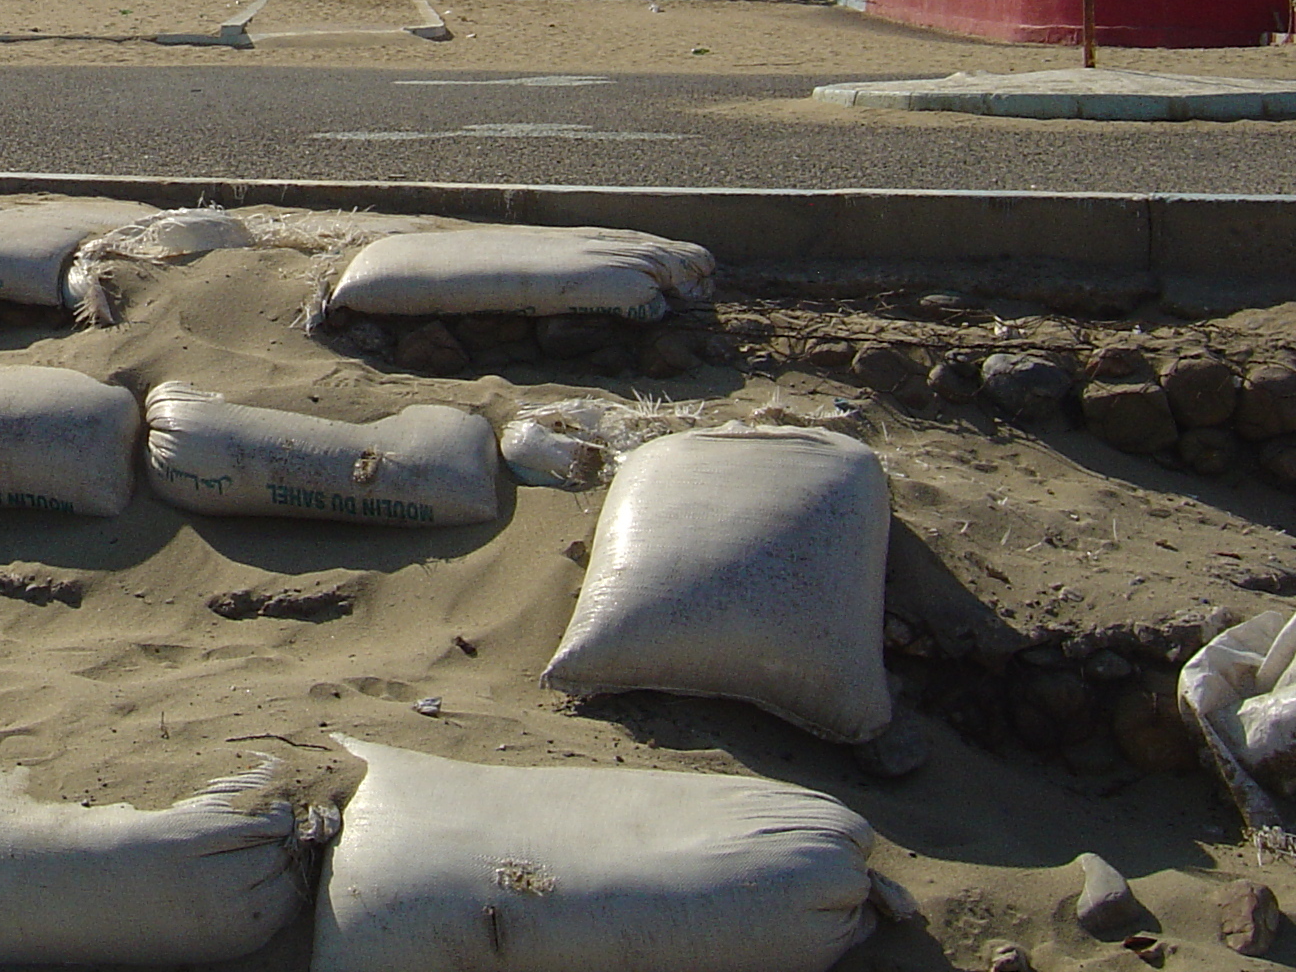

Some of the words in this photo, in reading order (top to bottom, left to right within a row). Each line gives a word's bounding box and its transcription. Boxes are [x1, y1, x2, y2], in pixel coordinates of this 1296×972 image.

[9, 493, 75, 513] MOULIN
[265, 484, 326, 510] SAHEL
[331, 494, 357, 516] DU
[362, 498, 435, 523] MOULIN
